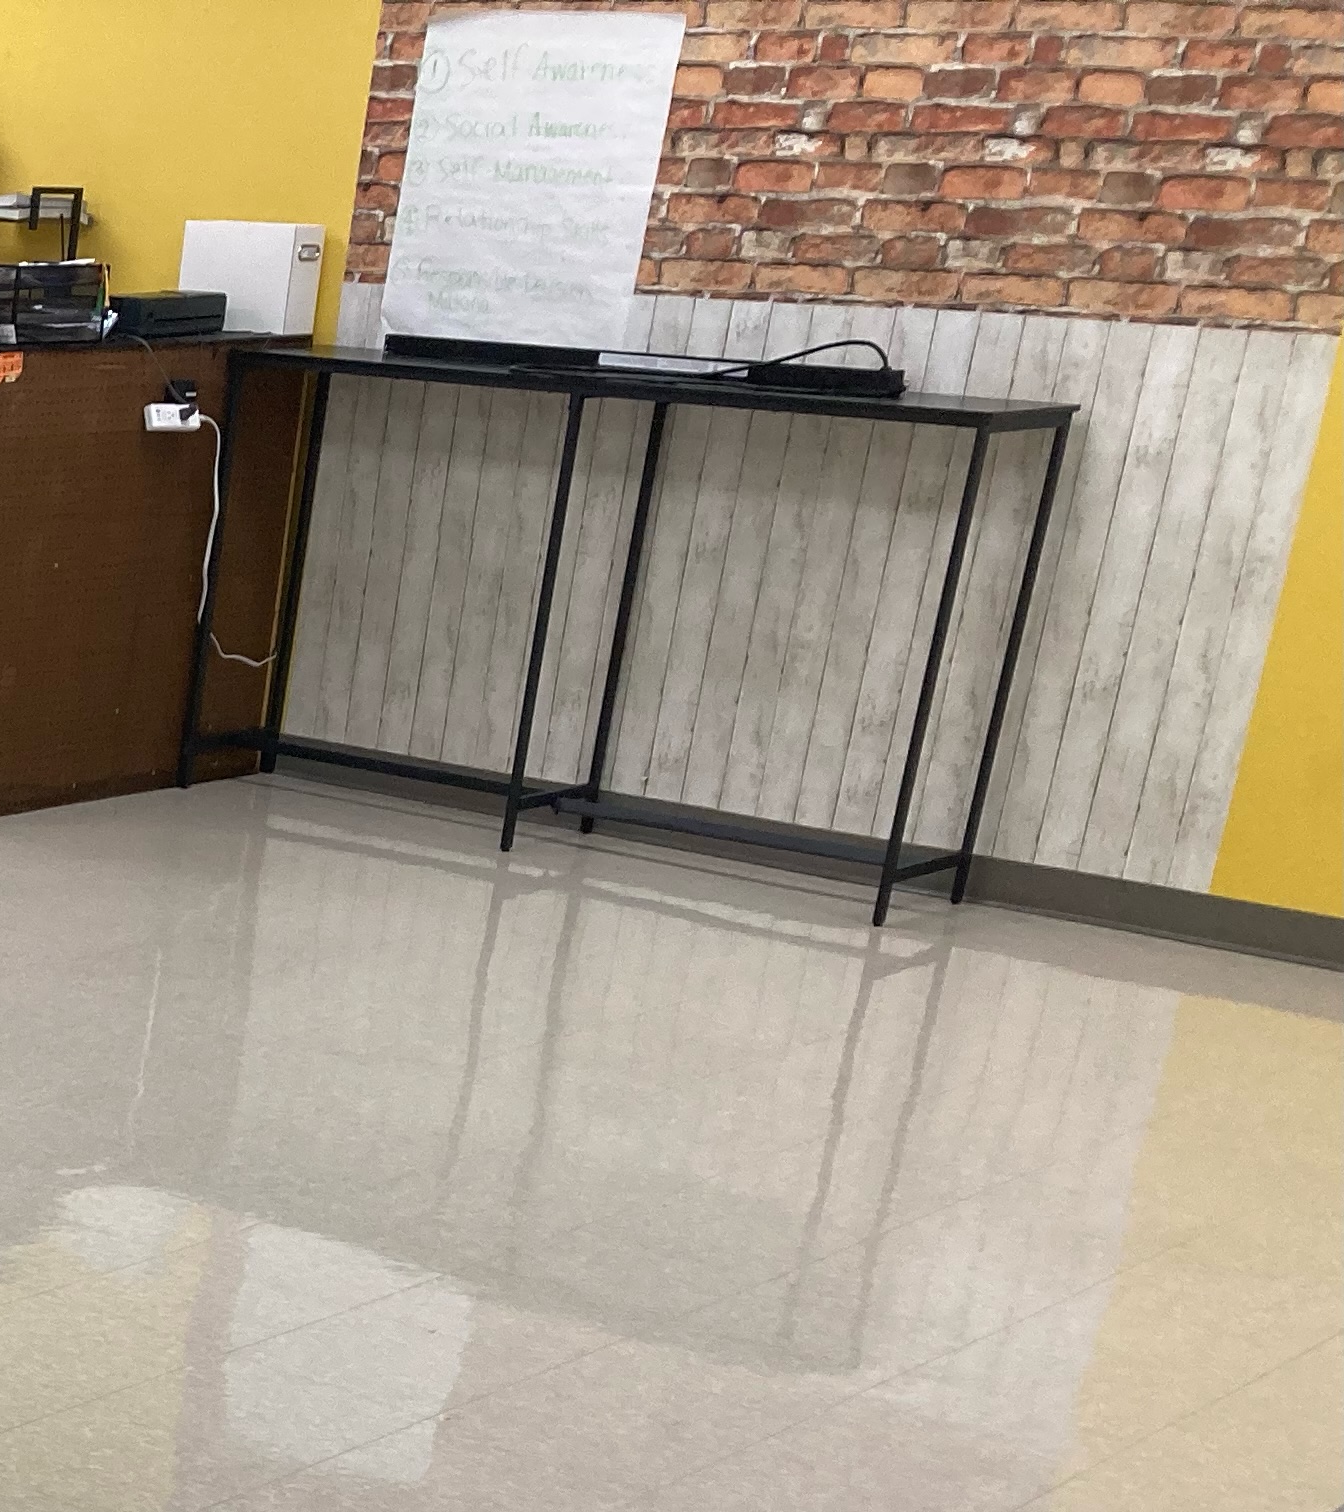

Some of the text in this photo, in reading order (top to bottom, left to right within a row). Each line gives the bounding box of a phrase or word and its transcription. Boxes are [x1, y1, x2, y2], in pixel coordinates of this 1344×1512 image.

[458, 42, 528, 88] Self
[444, 112, 519, 141] Social
[527, 111, 628, 140] Awarene
